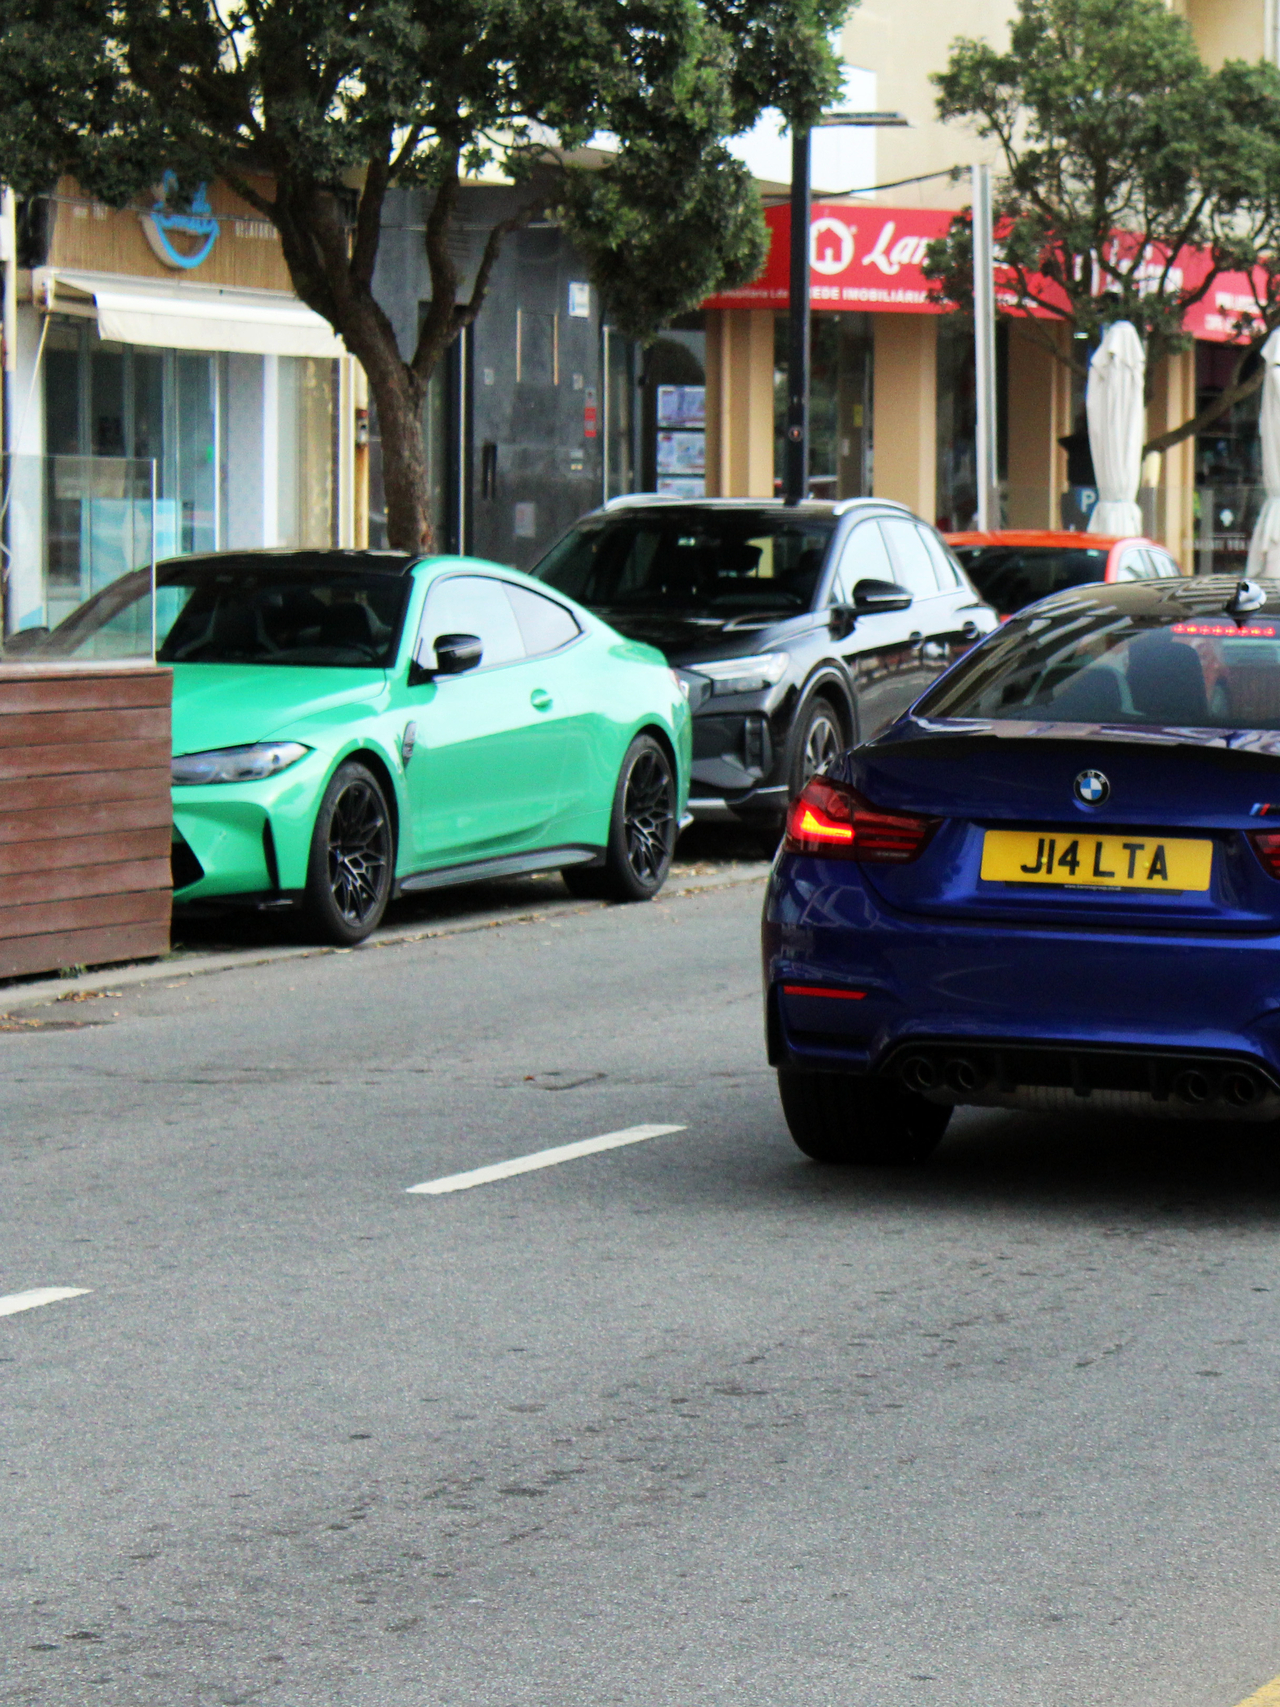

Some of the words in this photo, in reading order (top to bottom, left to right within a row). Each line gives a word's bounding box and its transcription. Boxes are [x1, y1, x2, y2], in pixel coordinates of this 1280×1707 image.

[810, 285, 840, 300] EDE
[1081, 490, 1096, 513] P
[1092, 841, 1169, 881] LTA
